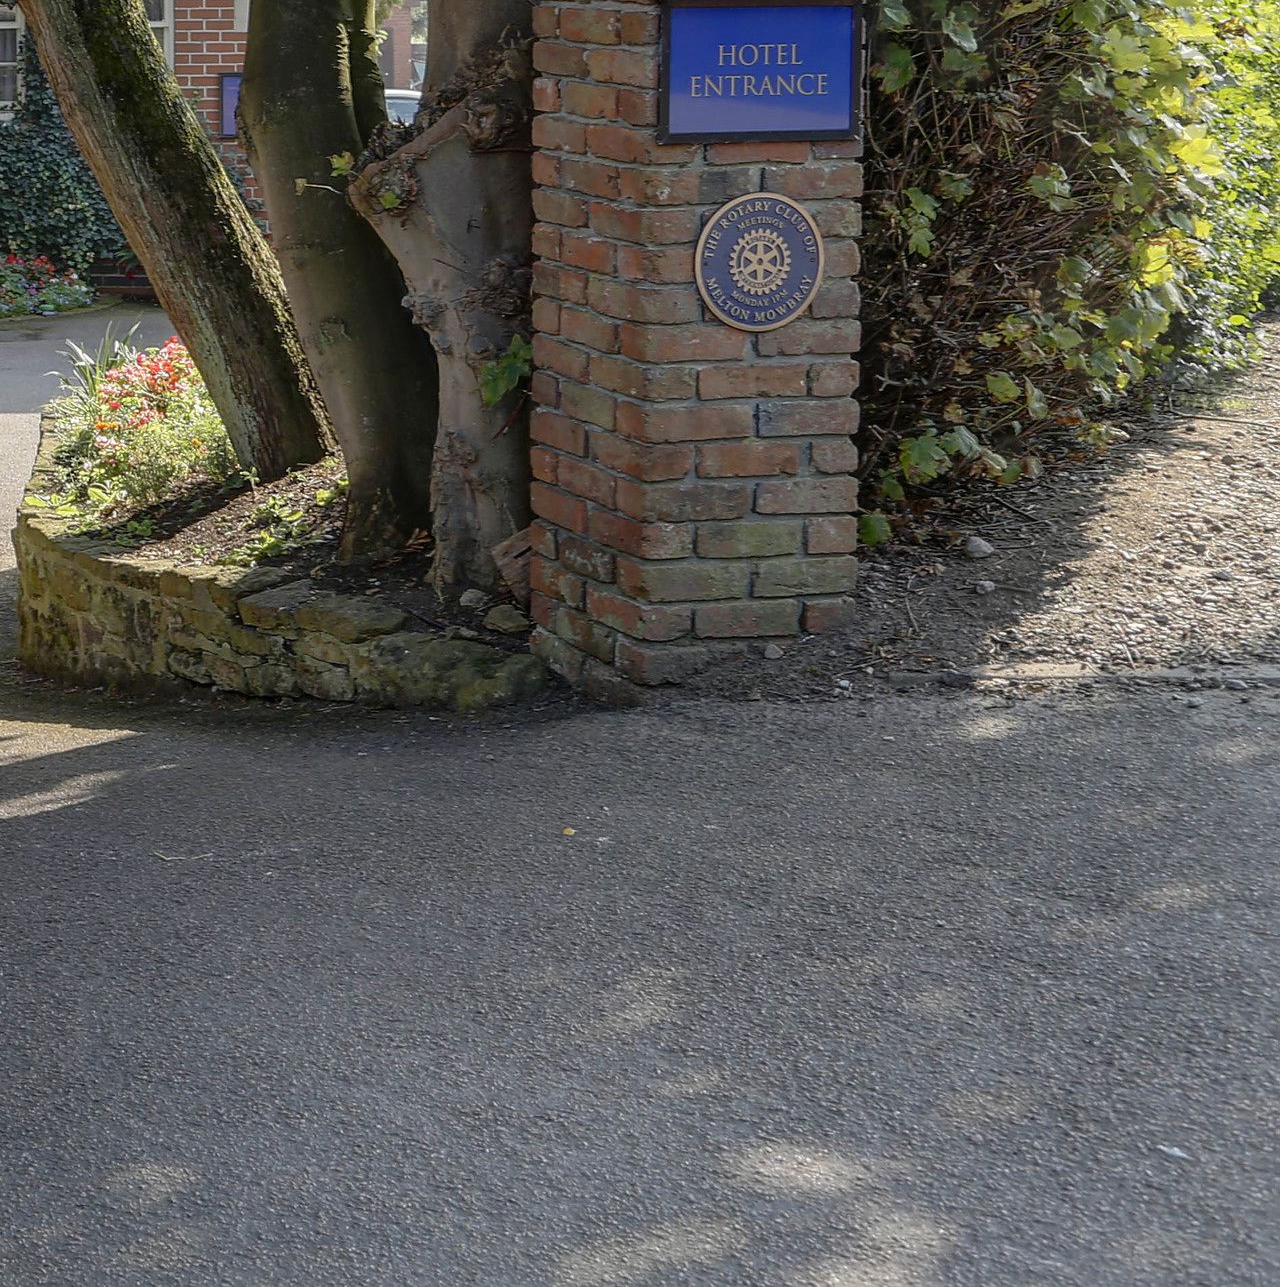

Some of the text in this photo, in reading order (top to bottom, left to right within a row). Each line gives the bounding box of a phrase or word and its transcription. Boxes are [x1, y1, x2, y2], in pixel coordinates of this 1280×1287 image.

[718, 43, 804, 66] HOTEL
[690, 73, 828, 98] ENTRANCE
[704, 201, 817, 259] THE ROTARY CLUB OF
[737, 216, 784, 231] MEETINGS
[706, 274, 813, 322] MELTON MOWBRAY
[731, 290, 769, 307] MONDAY
